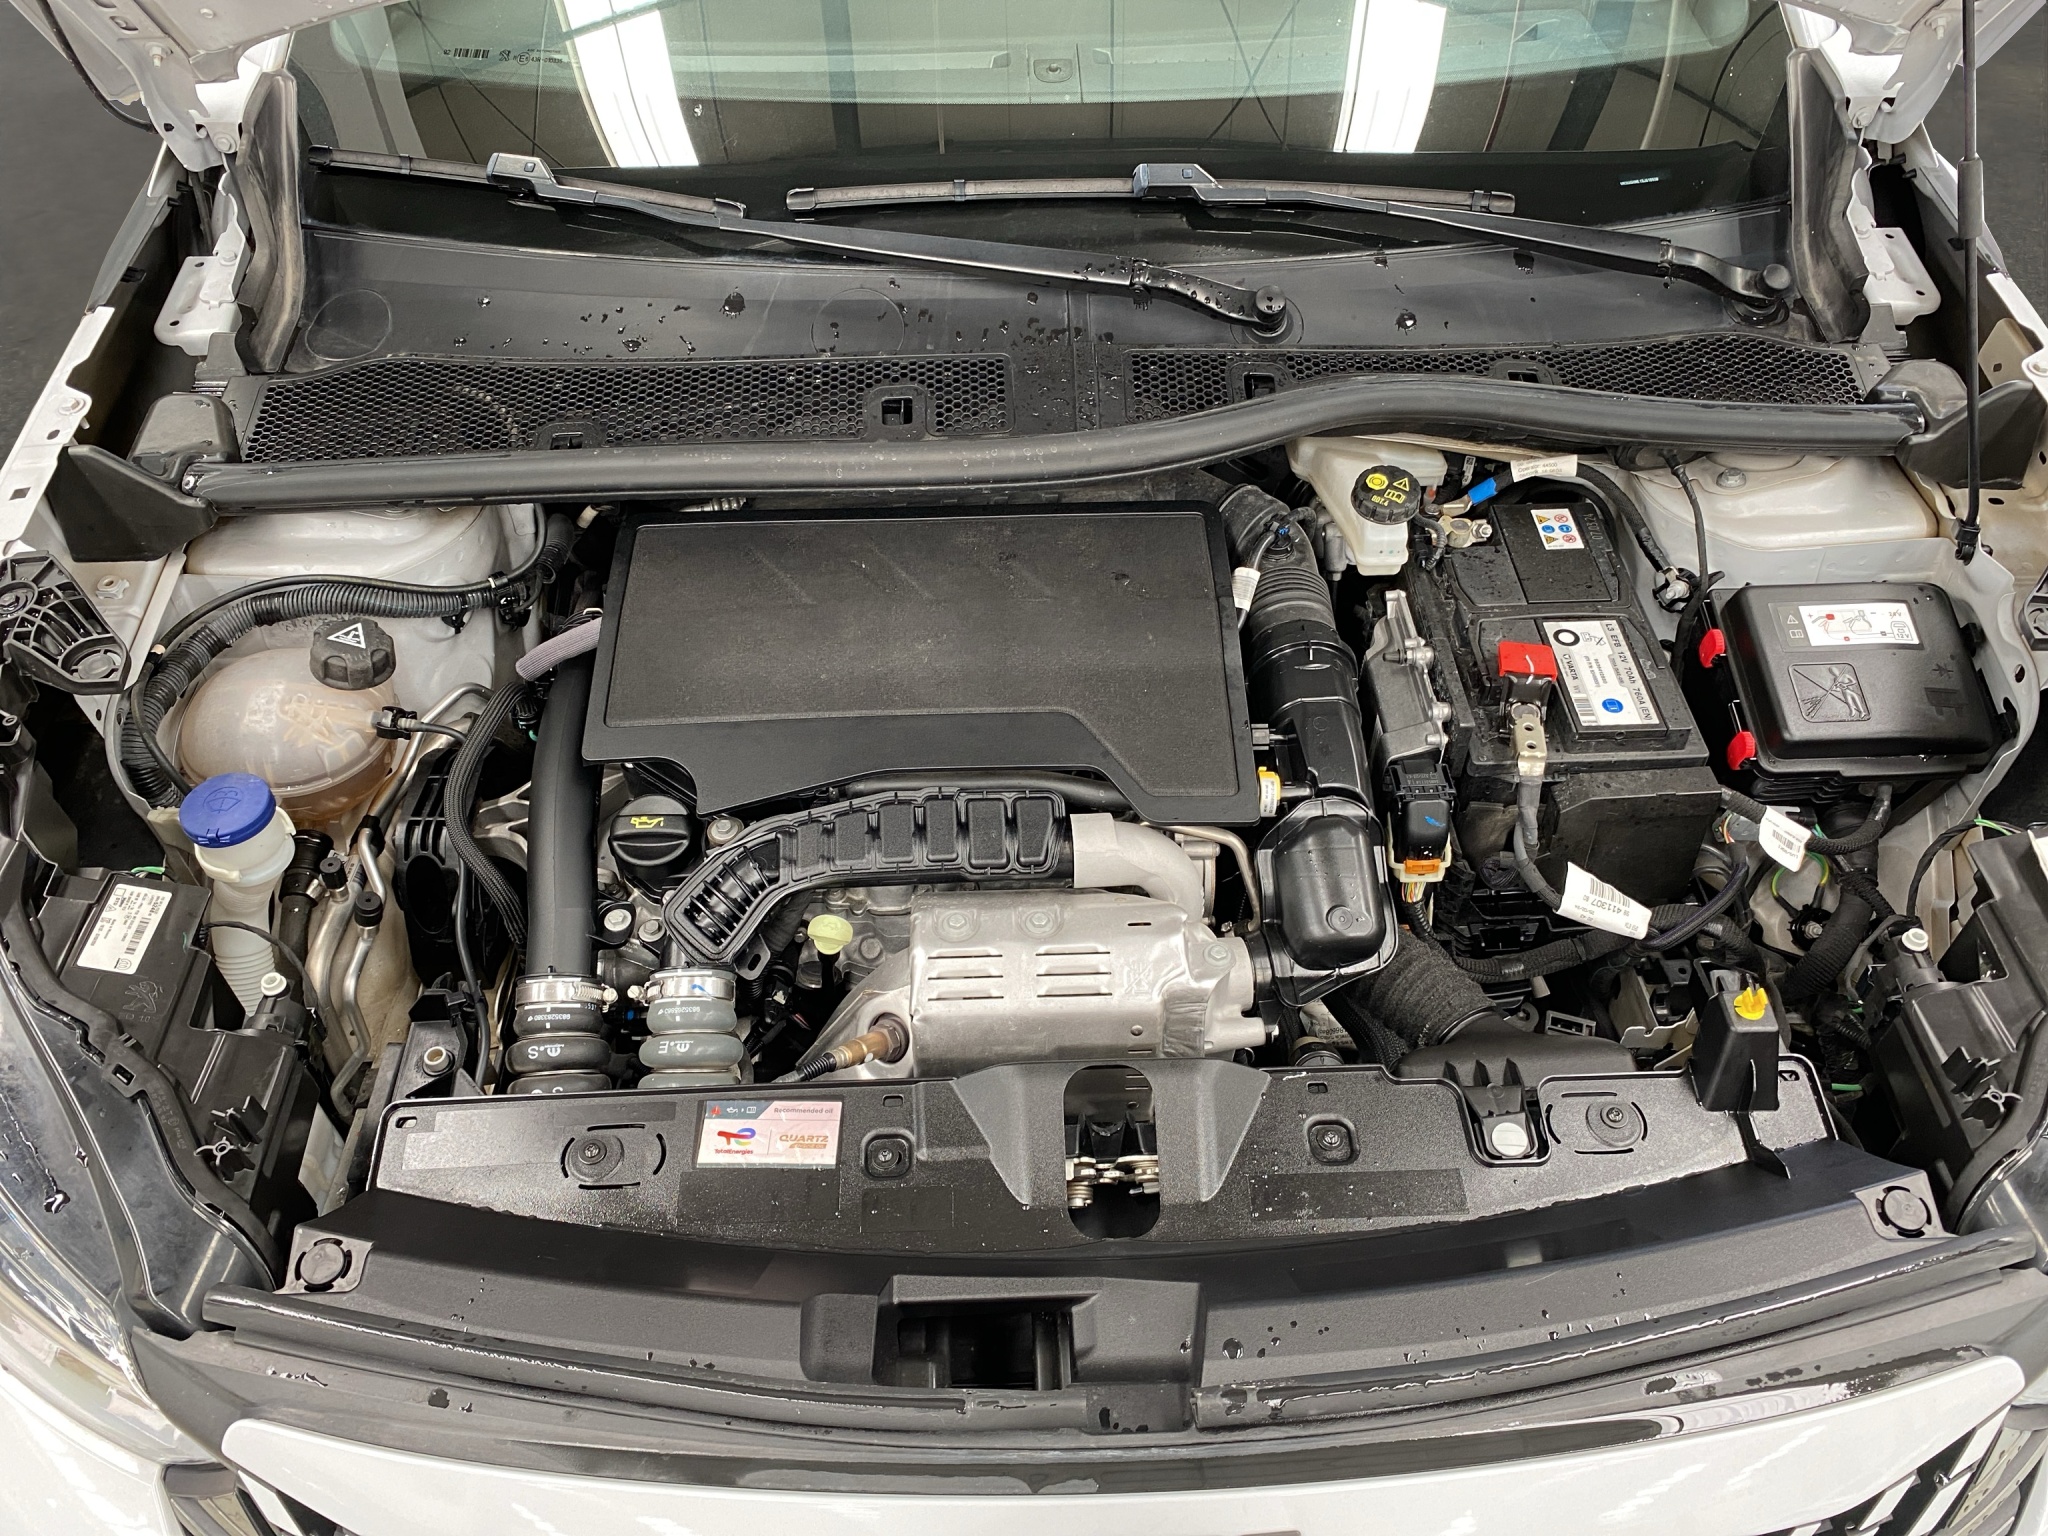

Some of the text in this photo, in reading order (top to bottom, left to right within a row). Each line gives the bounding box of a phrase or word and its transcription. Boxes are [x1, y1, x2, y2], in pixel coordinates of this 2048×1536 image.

[1566, 660, 1579, 681] VARTA
[1610, 634, 1622, 648] EFB
[1617, 651, 1629, 664] 12V
[1624, 667, 1637, 684] 70Ah
[1632, 687, 1646, 706] 760A
[1640, 707, 1653, 720] (EN)
[1591, 898, 1622, 914] 411307
[825, 1106, 833, 1114] oil
[779, 1134, 829, 1142] QUARTZ
[714, 1148, 754, 1156] TotalEnergies
